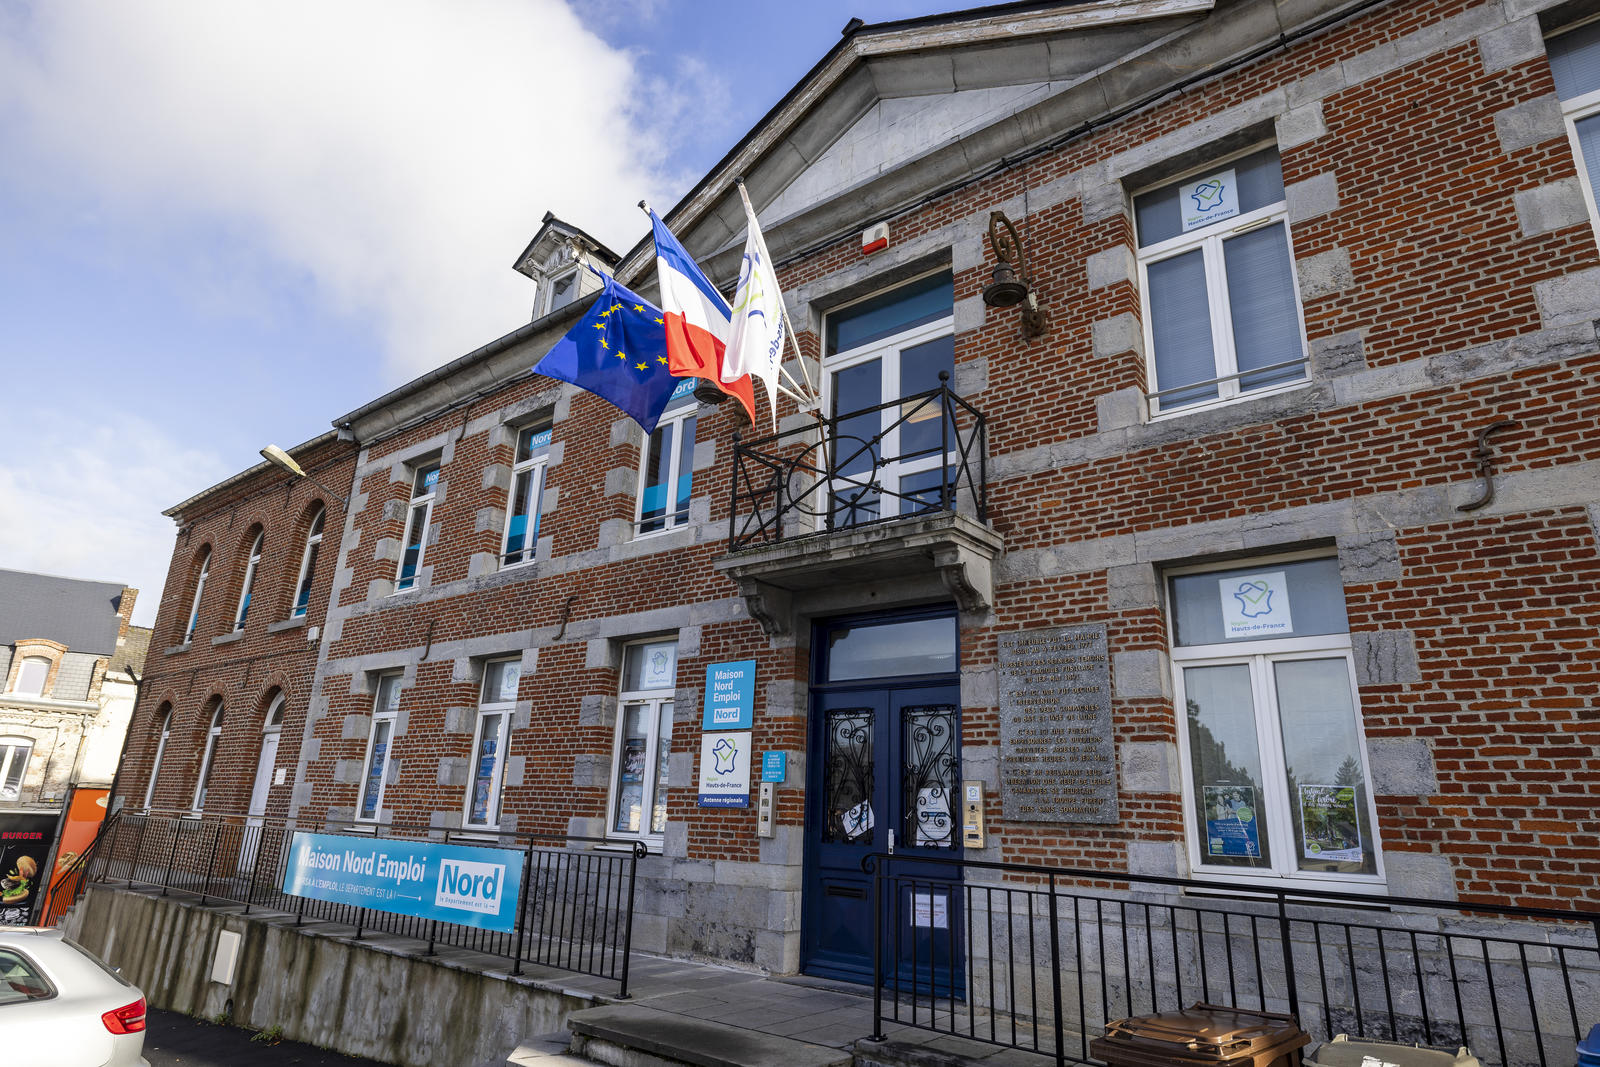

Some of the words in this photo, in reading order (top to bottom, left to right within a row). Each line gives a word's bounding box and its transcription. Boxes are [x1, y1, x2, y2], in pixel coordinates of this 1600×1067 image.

[1188, 208, 1234, 226] Hauts-de-France
[672, 377, 696, 394] ord
[426, 472, 440, 484] Nor
[1232, 623, 1286, 632] Hauts-de-France
[1074, 632, 1099, 641] MAIRIE
[714, 670, 744, 680] Maison
[714, 681, 734, 692] Nord
[713, 690, 741, 704] Emploi
[715, 708, 739, 720] Nord
[298, 845, 341, 871] Maison
[343, 850, 376, 876] Nord
[376, 854, 427, 886] Emploi
[441, 864, 500, 900] Nord
[376, 888, 386, 898] EST
